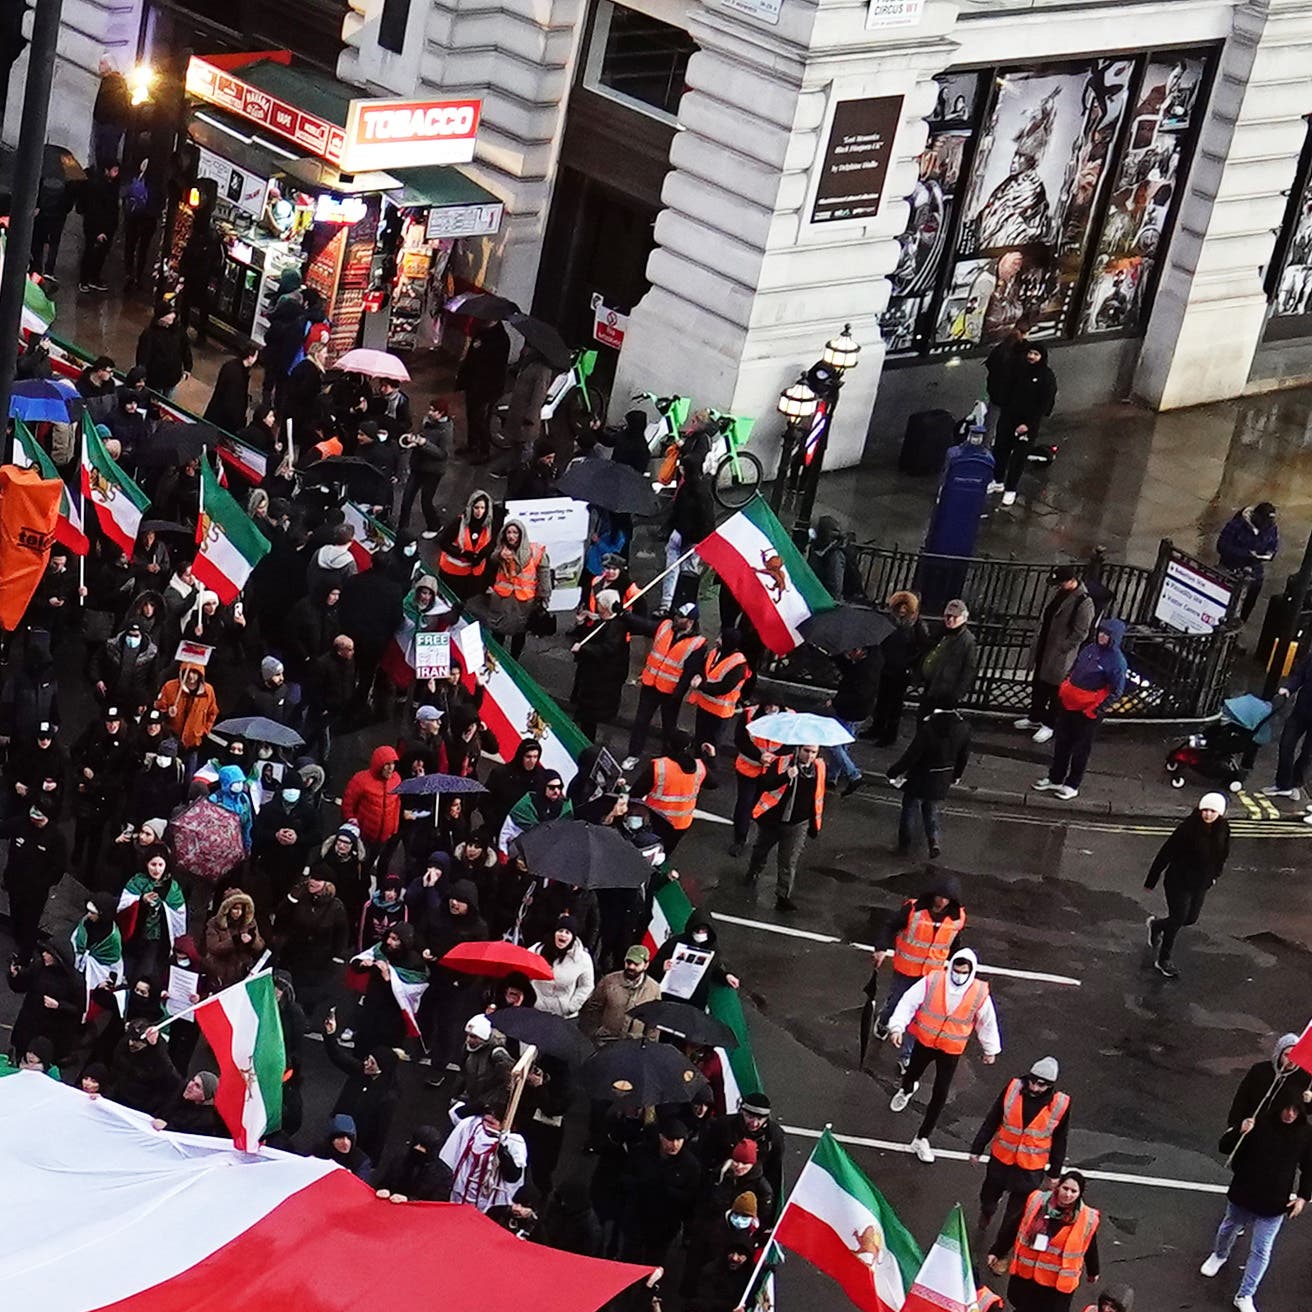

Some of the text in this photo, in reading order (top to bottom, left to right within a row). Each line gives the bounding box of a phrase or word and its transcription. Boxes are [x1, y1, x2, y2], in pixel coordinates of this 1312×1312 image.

[363, 106, 474, 140] TOBACCO
[417, 634, 449, 646] FREE
[417, 666, 449, 678] IRAN
